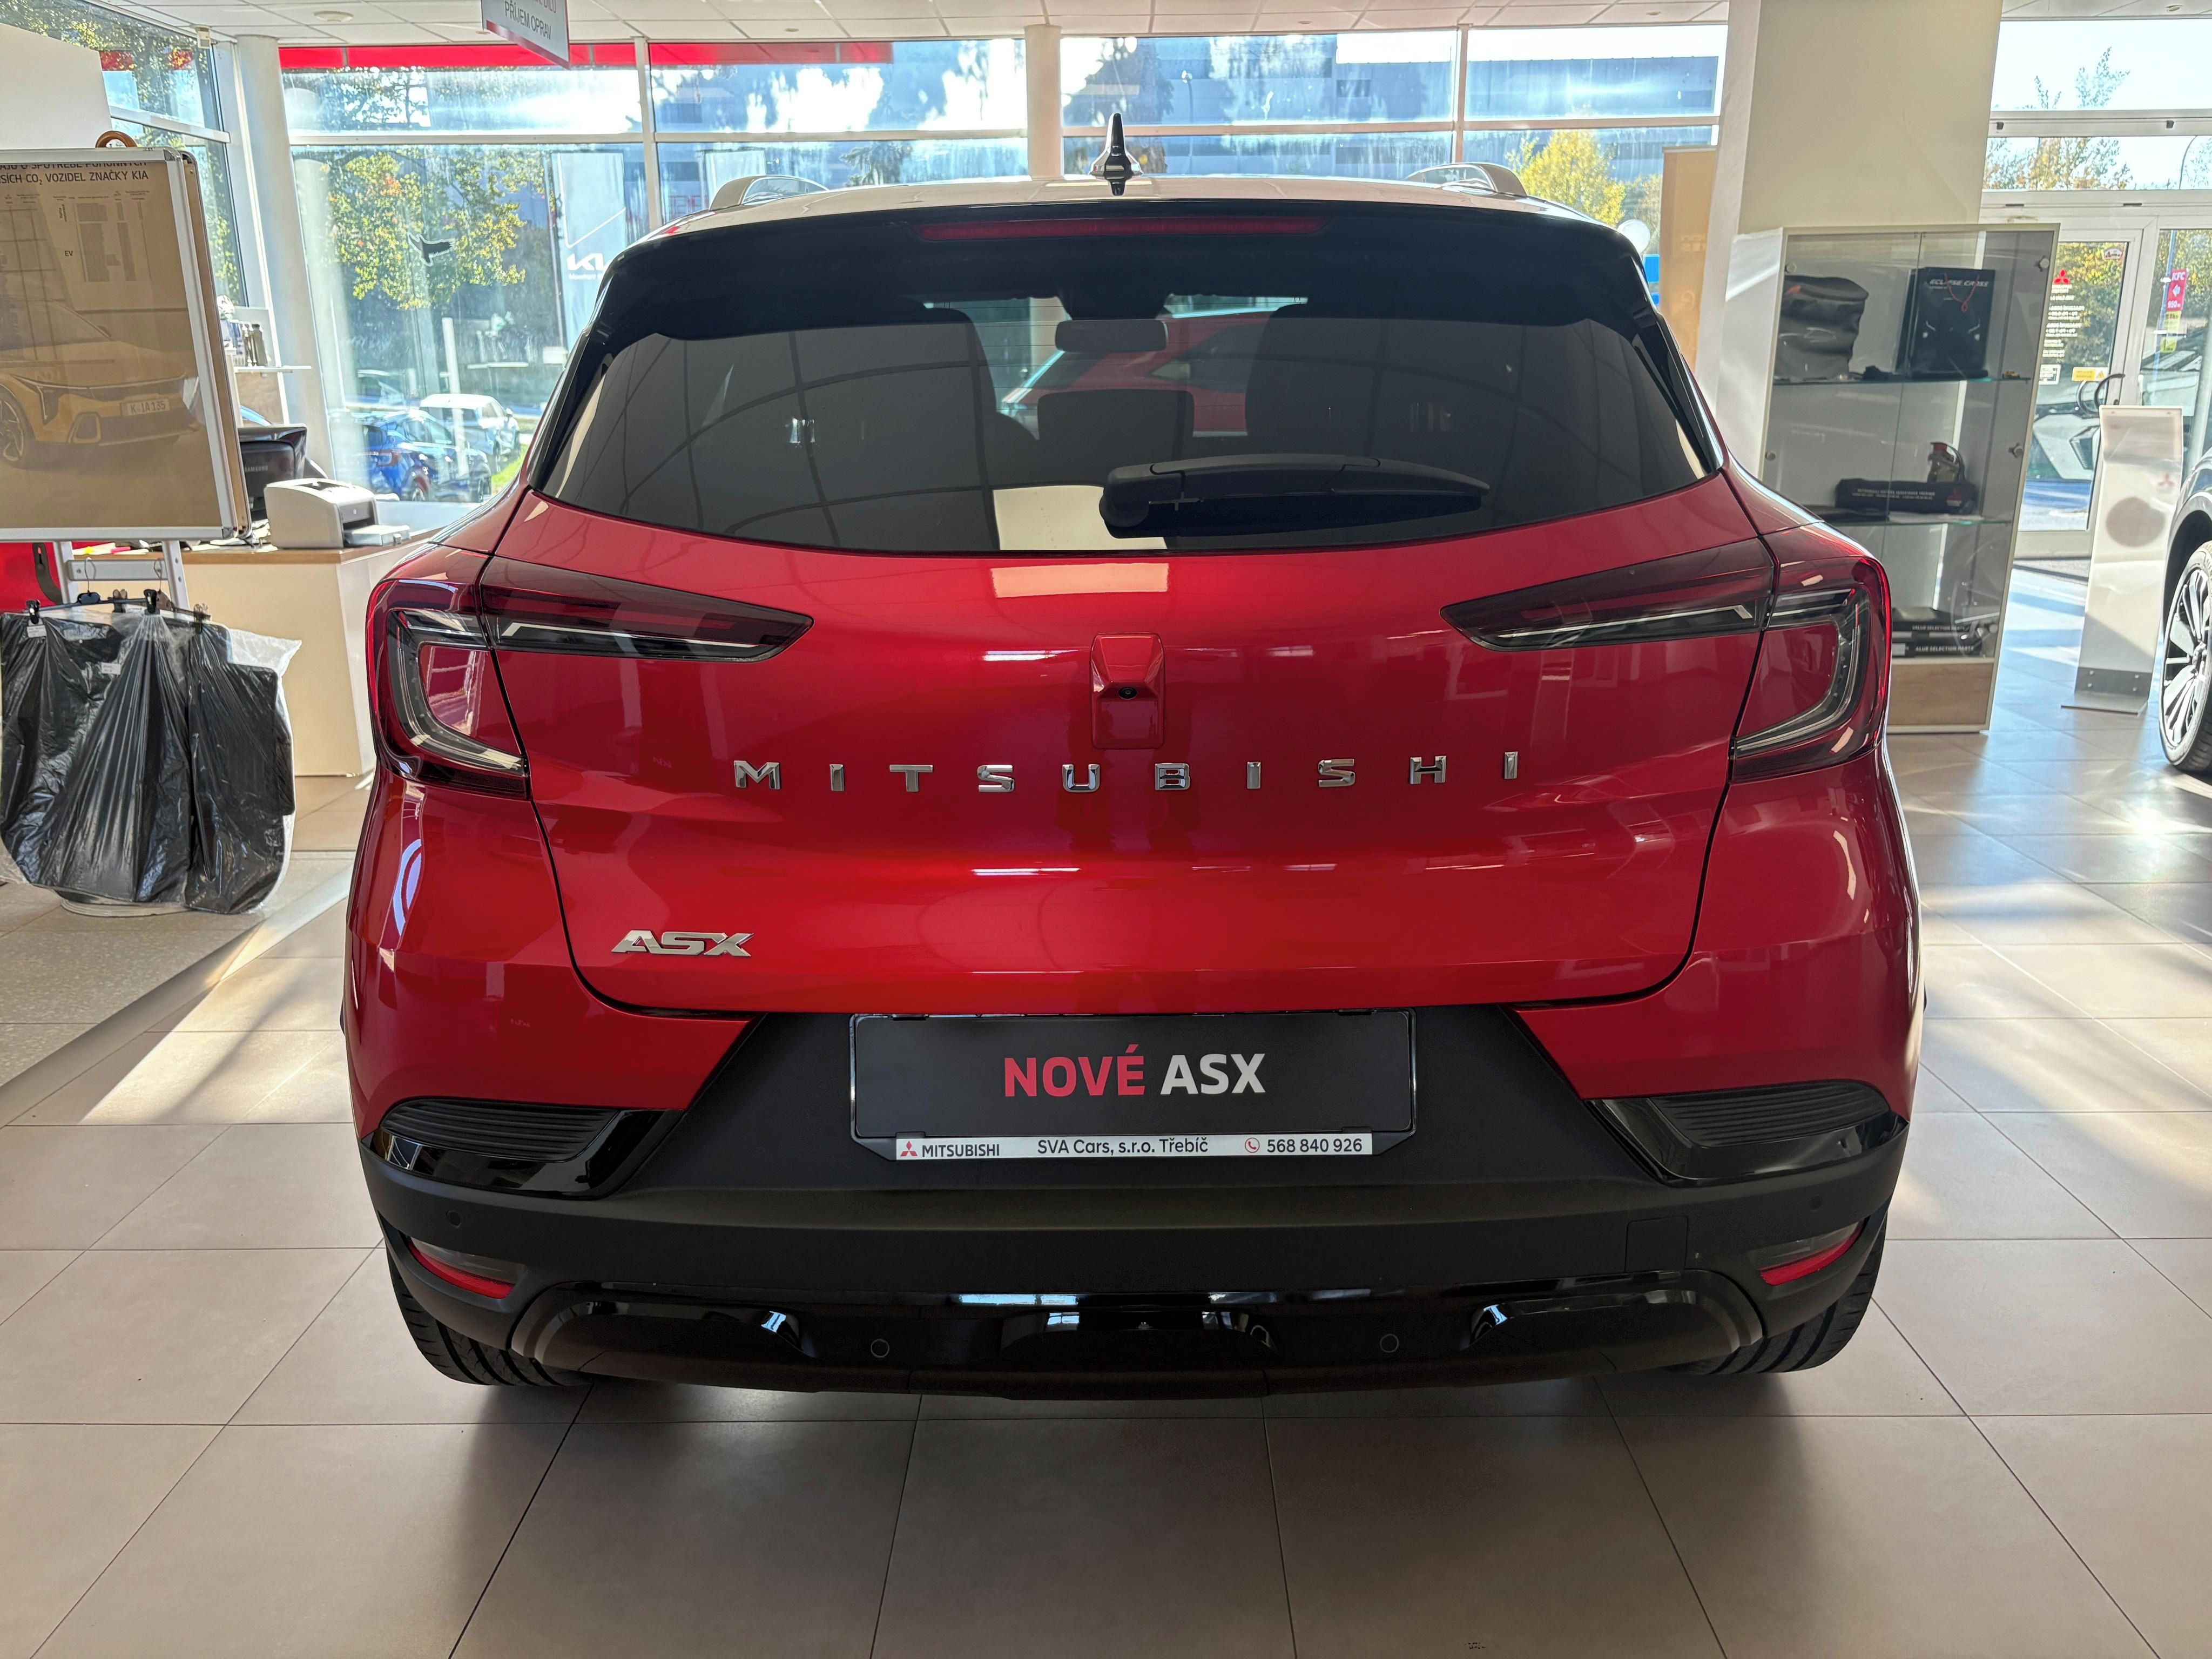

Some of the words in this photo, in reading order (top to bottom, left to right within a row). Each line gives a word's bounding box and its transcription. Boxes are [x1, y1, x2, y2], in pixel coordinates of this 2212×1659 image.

[504, 1, 530, 29] PŘÍJEM
[531, 15, 551, 40] OPRAV
[0, 172, 22, 184] SÍCH
[46, 172, 86, 183] VOZIDEL
[89, 170, 127, 181] ZNAČKY
[132, 170, 149, 180] KIA
[2171, 272, 2186, 281] KFC
[733, 751, 1518, 793] MITSUBISHI
[611, 929, 754, 957] ASX
[1004, 1043, 1145, 1097] NOVÉ
[1161, 1053, 1266, 1095] ASX
[922, 1143, 1000, 1157] MITSUBISHI
[1037, 1139, 1069, 1154] SVA
[1073, 1139, 1114, 1156] Cars,
[1118, 1141, 1155, 1154] s.r.o.
[1159, 1137, 1209, 1153] Třebíč
[1267, 1138, 1296, 1154] 568
[1299, 1138, 1329, 1153] 840
[1333, 1138, 1363, 1152] 926
